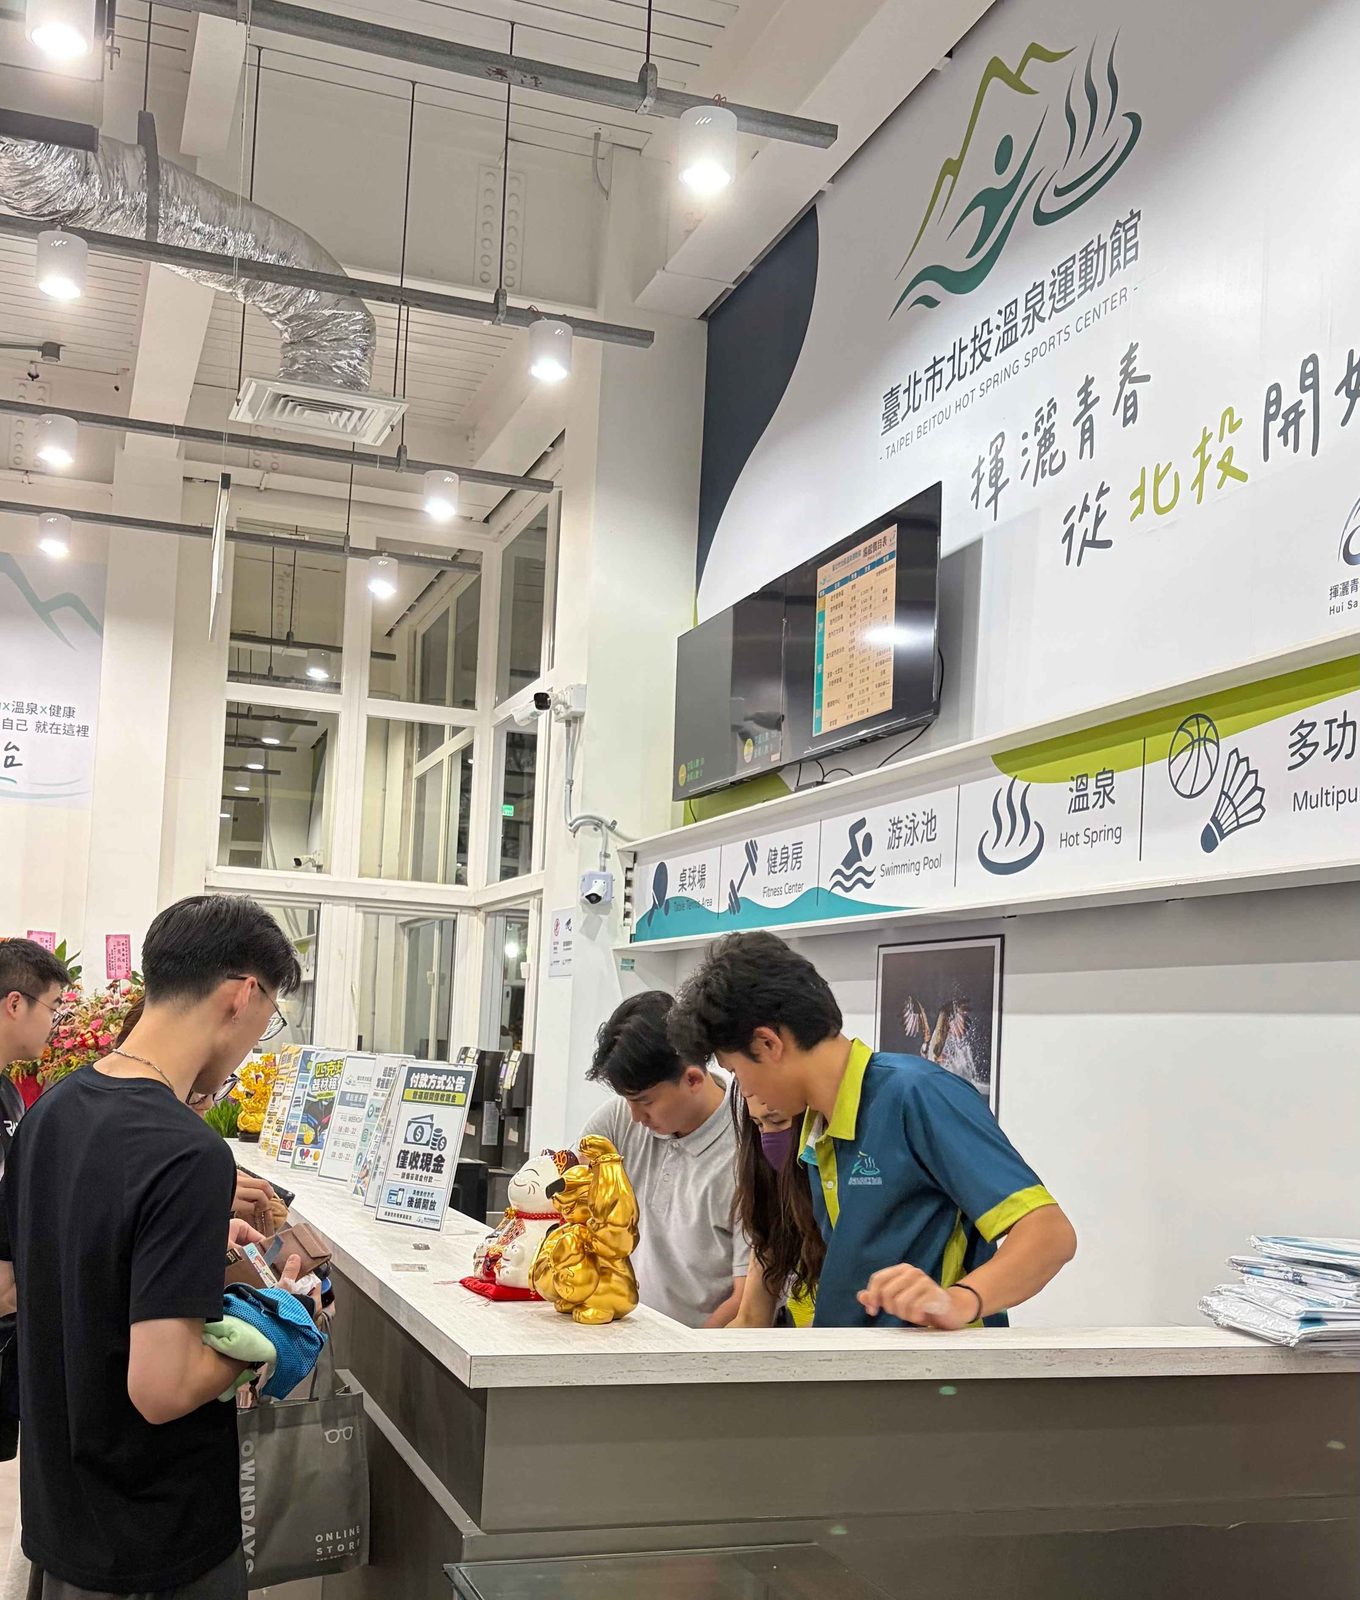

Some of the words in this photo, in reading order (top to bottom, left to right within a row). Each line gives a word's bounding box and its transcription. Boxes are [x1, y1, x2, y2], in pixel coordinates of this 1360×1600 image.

[880, 208, 1142, 437] 臺北市北投溫泉運動館
[916, 404, 952, 440] BEITOU
[954, 388, 977, 415] HOT
[978, 364, 1021, 399] SPRING
[1023, 331, 1072, 370] SPORTS
[1074, 286, 1130, 334] CENTER
[970, 341, 1152, 523] 揮灑青春
[1328, 602, 1344, 616] Hui
[1346, 599, 1359, 610] Sa
[1, 717, 29, 732] 自己
[34, 720, 90, 738] 就在這裡
[1287, 709, 1357, 772] 多功
[1067, 767, 1116, 815] 溫泉
[1292, 785, 1358, 812] Multipu
[886, 807, 938, 851] 游泳池
[1058, 828, 1081, 849] Hot
[1083, 823, 1123, 847] Spring
[767, 840, 804, 876] 健身房
[879, 858, 921, 878] Swimming
[922, 852, 942, 871] Pool
[678, 863, 707, 893] 桌球場
[762, 886, 783, 898] Fitness
[783, 882, 805, 895] Center
[312, 1077, 340, 1092] 器材租
[410, 1072, 466, 1092] 付款方式公告
[396, 1149, 446, 1175] 僅收現金
[315, 1525, 360, 1543] ONLINE
